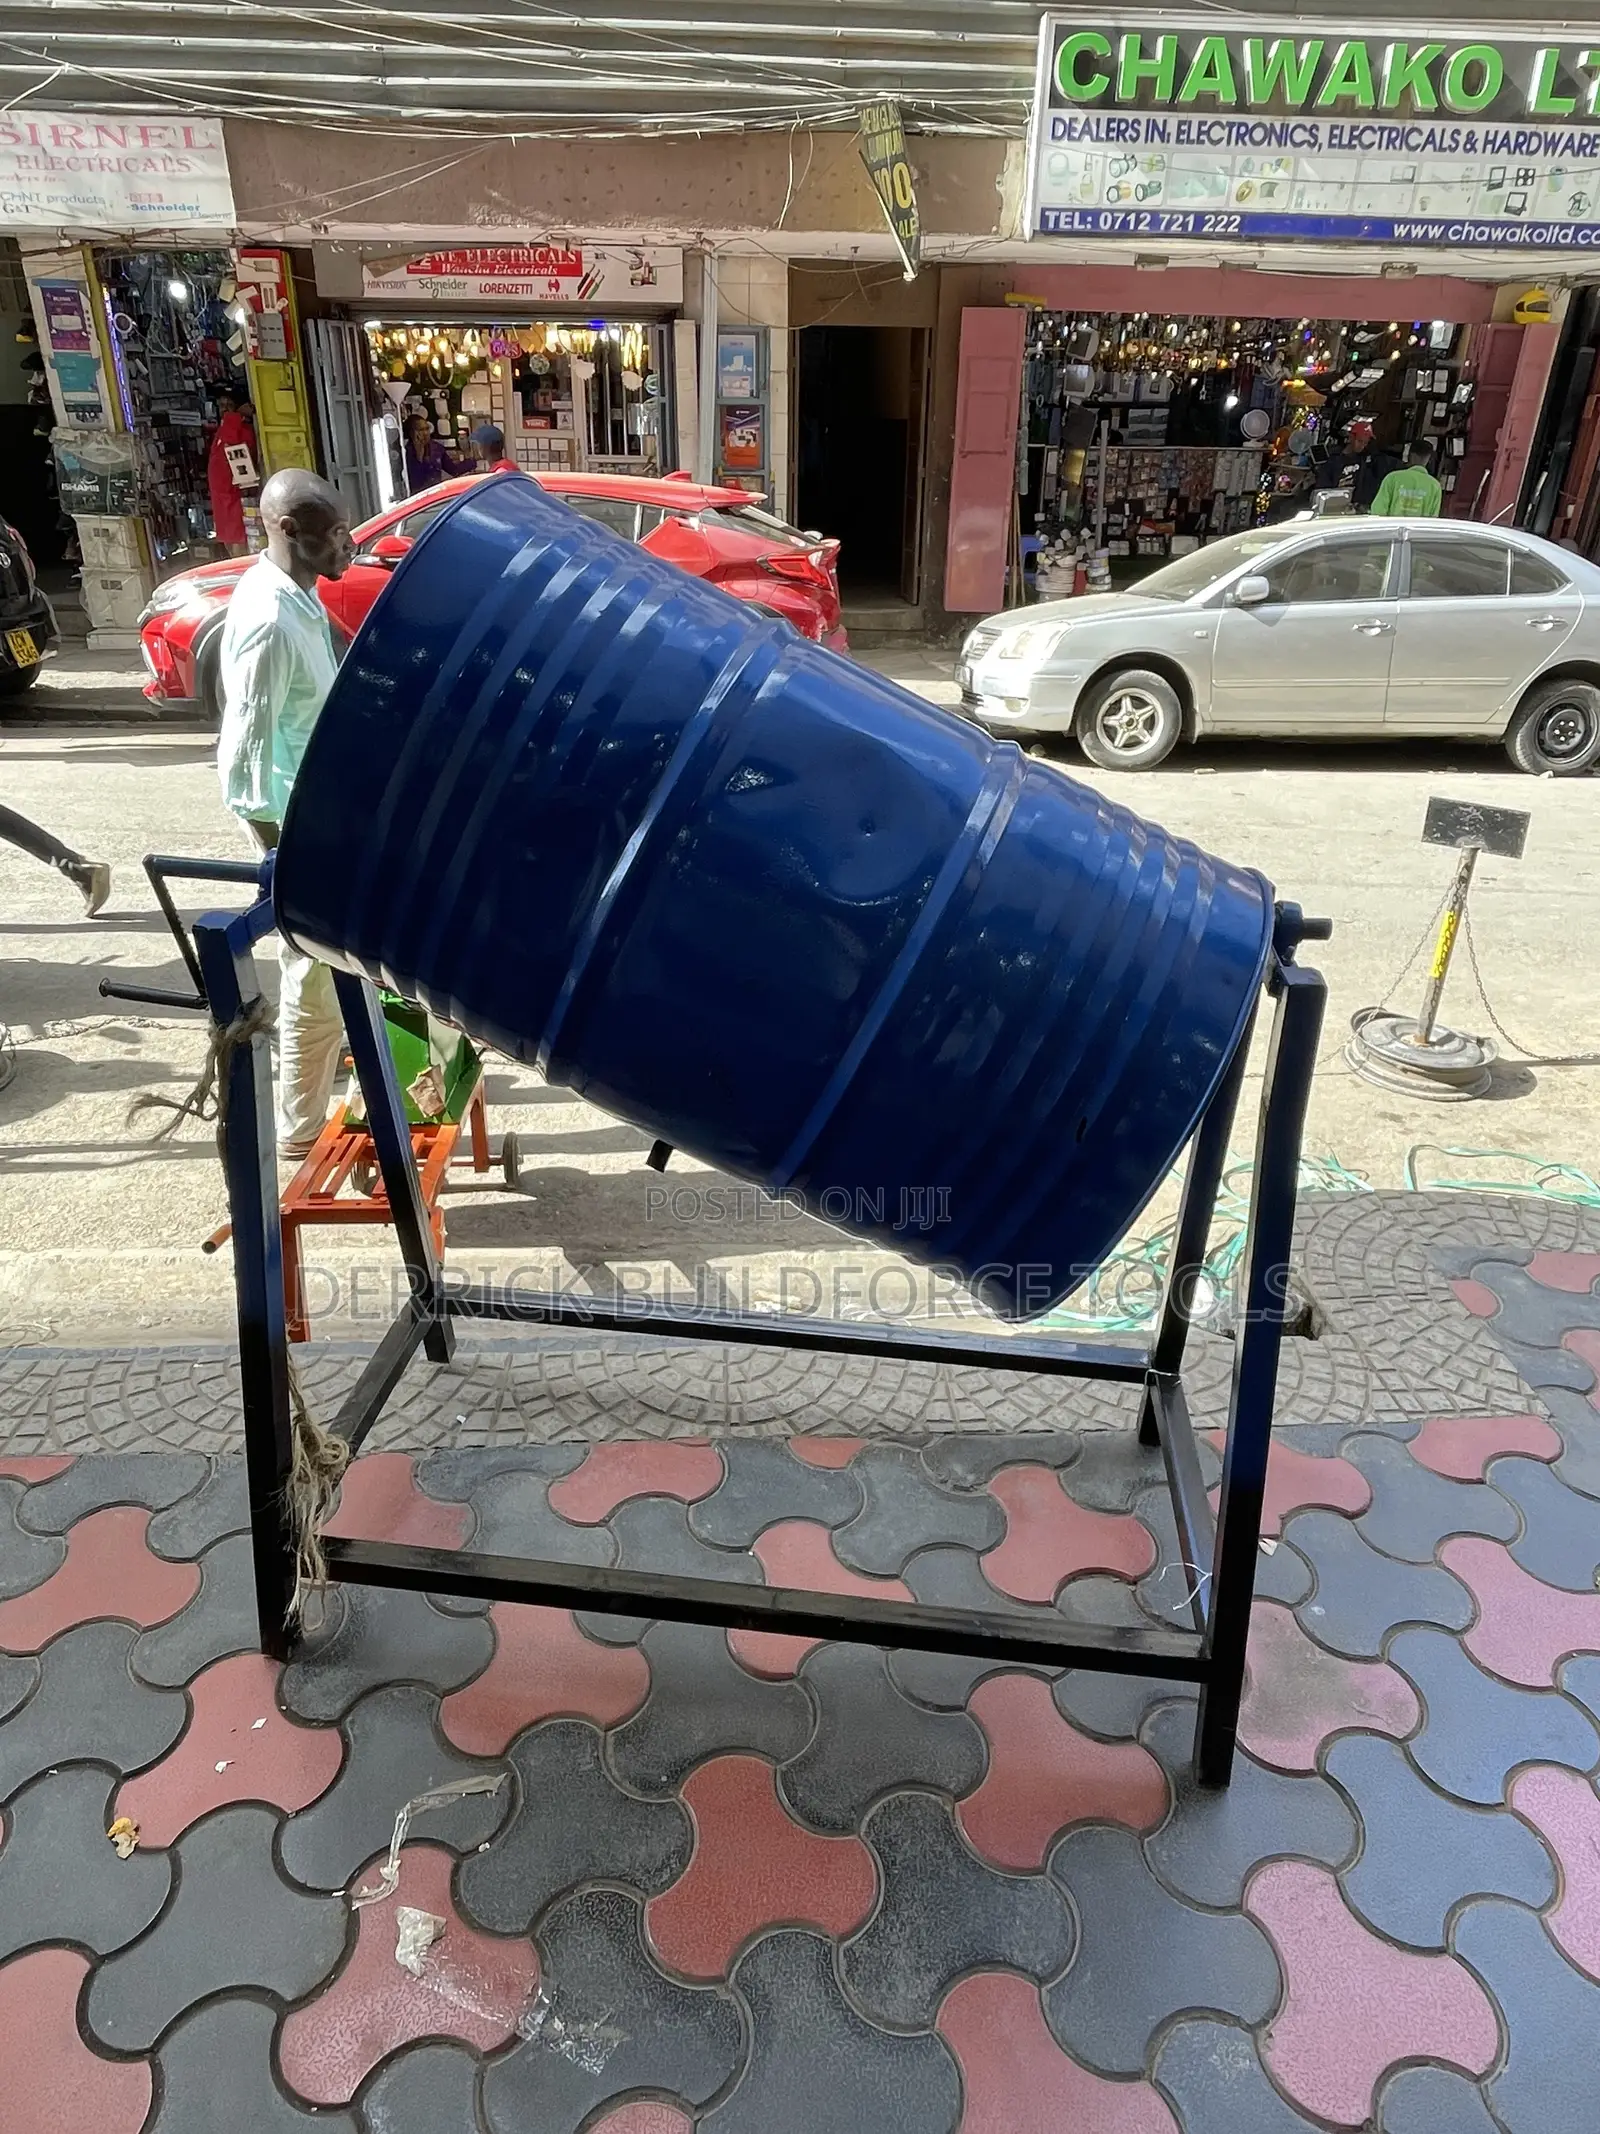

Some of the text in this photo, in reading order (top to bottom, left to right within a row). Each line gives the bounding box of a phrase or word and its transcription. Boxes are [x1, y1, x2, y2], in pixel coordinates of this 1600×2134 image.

[1054, 32, 1503, 114] CHAWAKO
[0, 122, 217, 150] SIRNEL
[1051, 116, 1141, 143] DEALERS
[1176, 119, 1322, 152] ELECTRONICS,
[1327, 124, 1462, 154] ELECTRICALS
[1463, 129, 1479, 155] &
[1482, 129, 1600, 158] HARDWARE
[16, 153, 192, 174] ELECTRICALS
[46, 194, 105, 206] products
[1045, 211, 1241, 233] TEL: 0712 721 222
[465, 247, 578, 265] ELECTRICALS
[494, 264, 558, 276] Electricals
[419, 277, 468, 291] Schneider
[479, 282, 533, 295] LORENZETTI
[539, 293, 570, 301] HAVELLS
